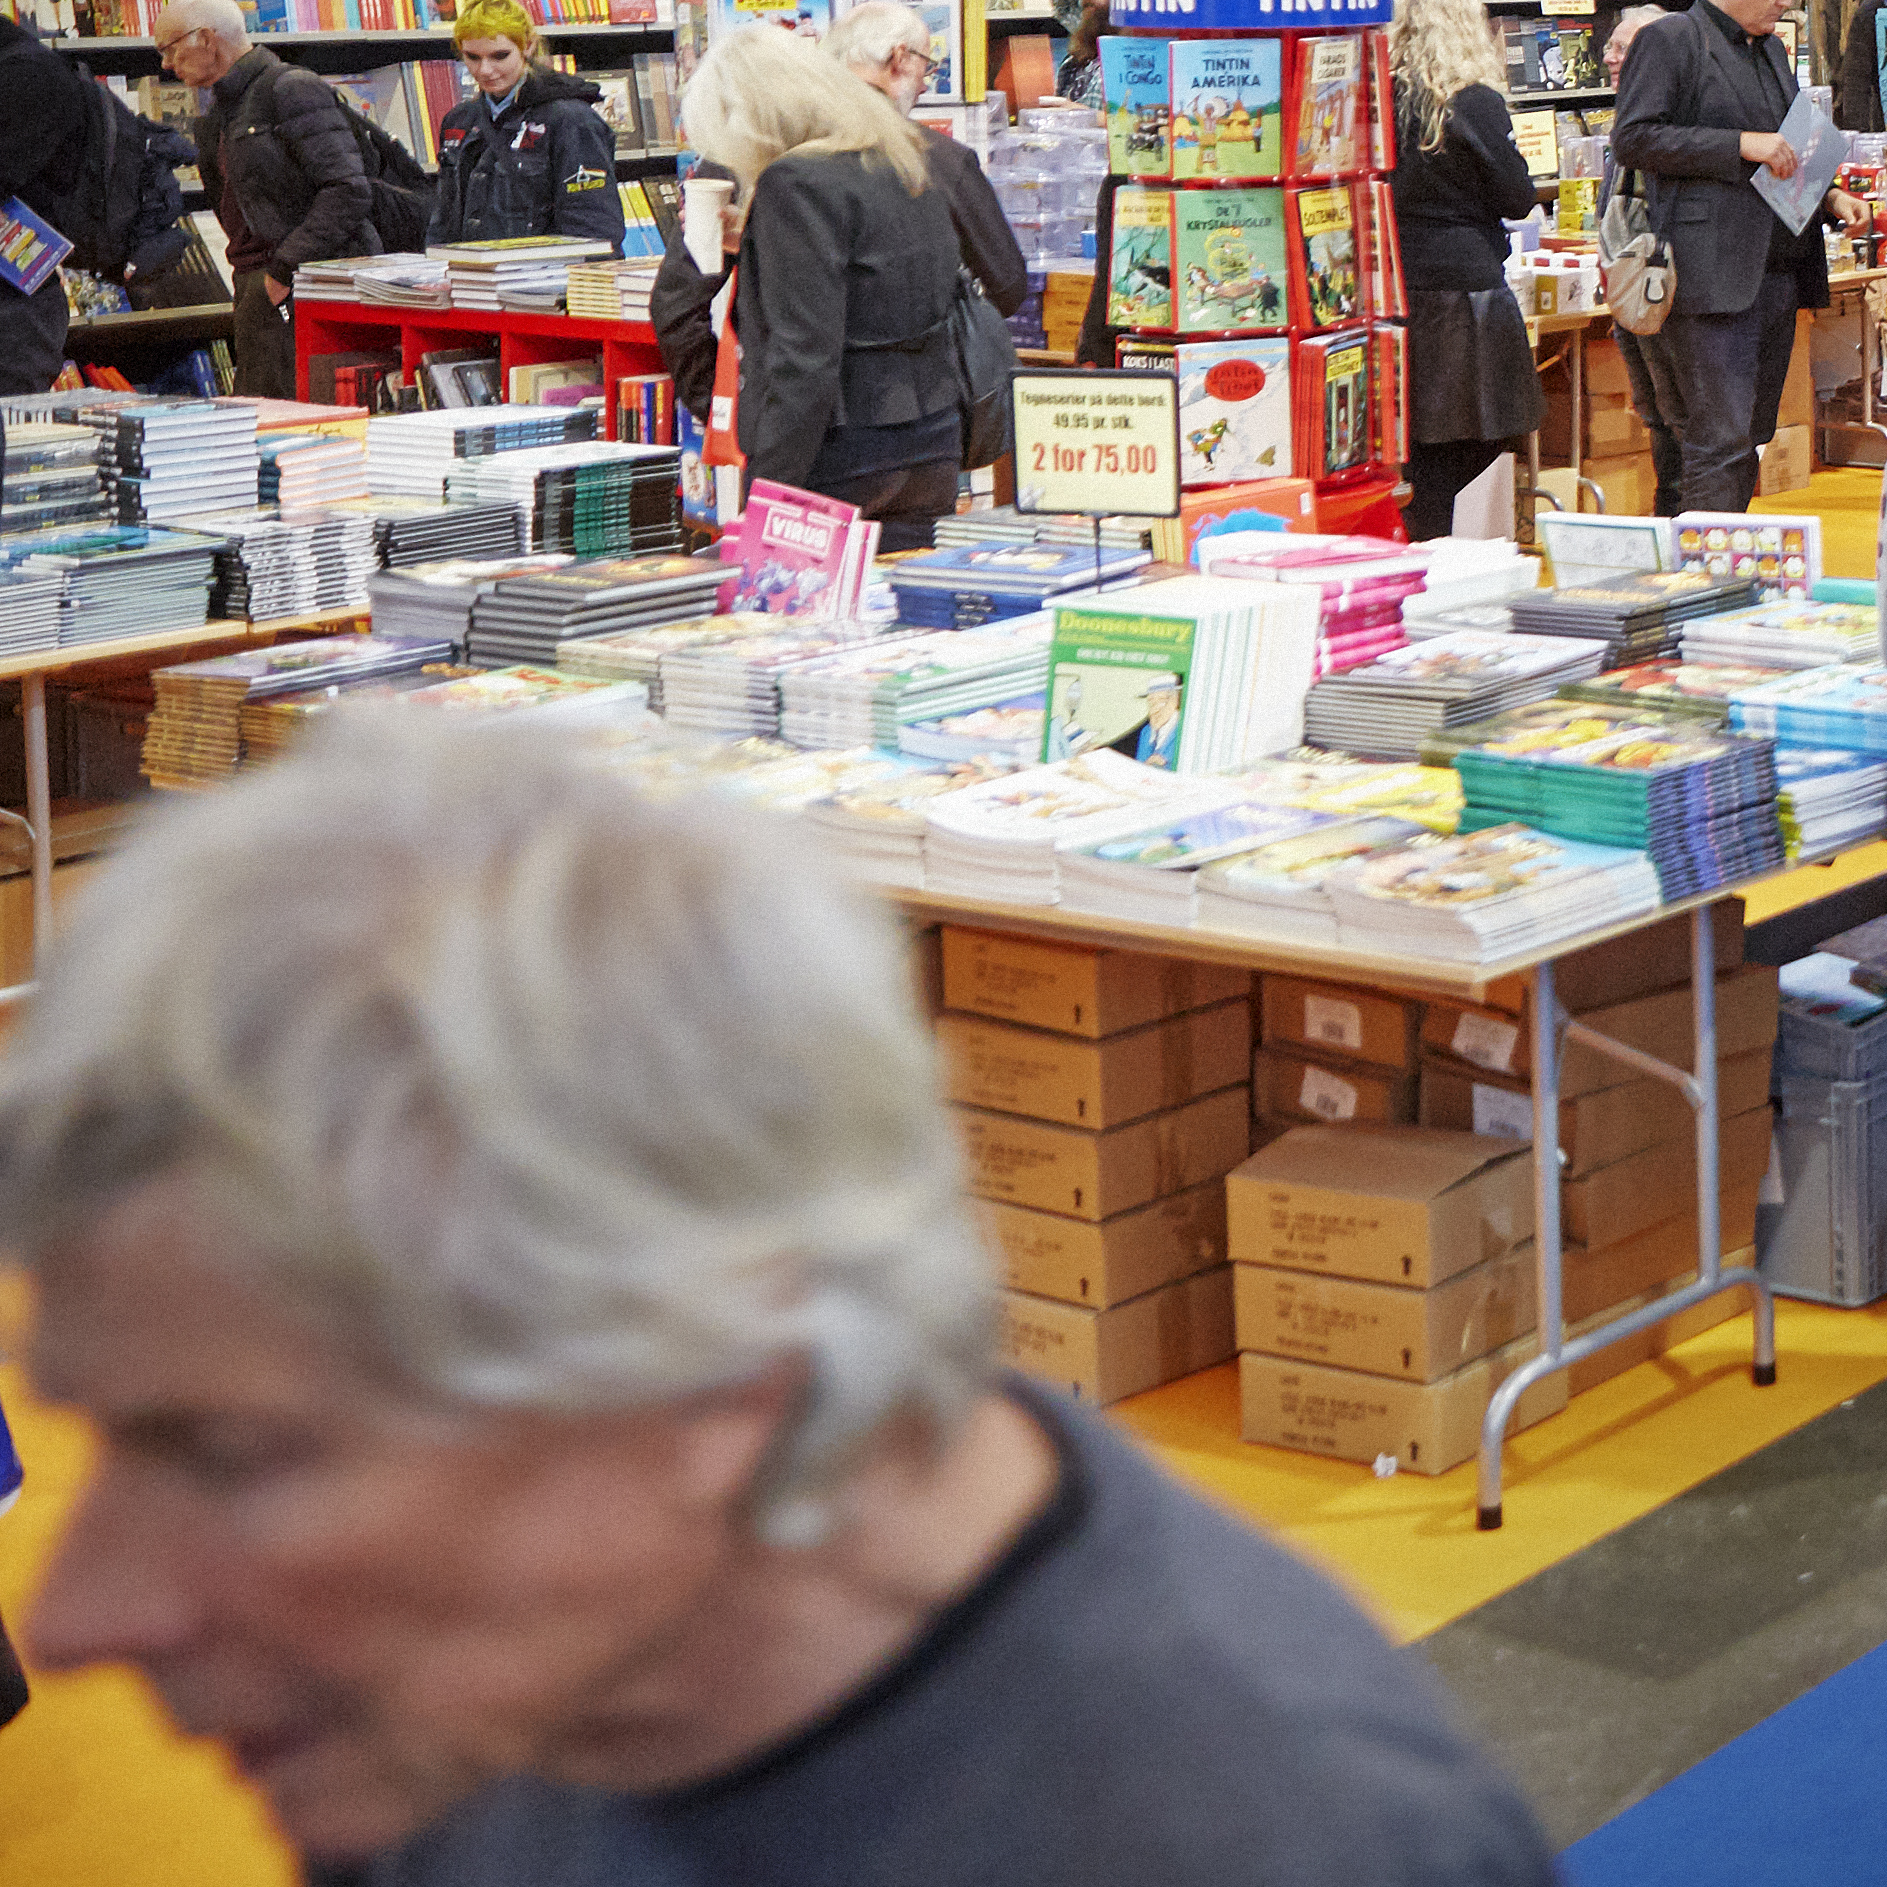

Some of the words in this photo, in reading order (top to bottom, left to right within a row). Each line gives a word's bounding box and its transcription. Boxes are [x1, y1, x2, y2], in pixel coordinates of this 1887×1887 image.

[1202, 57, 1250, 72] TINTIN
[1032, 442, 1046, 472] 2
[1052, 443, 1087, 472] for
[1092, 444, 1157, 476] 75,00
[771, 516, 828, 548] VIRUS
[1059, 611, 1193, 643] Doonesbury
